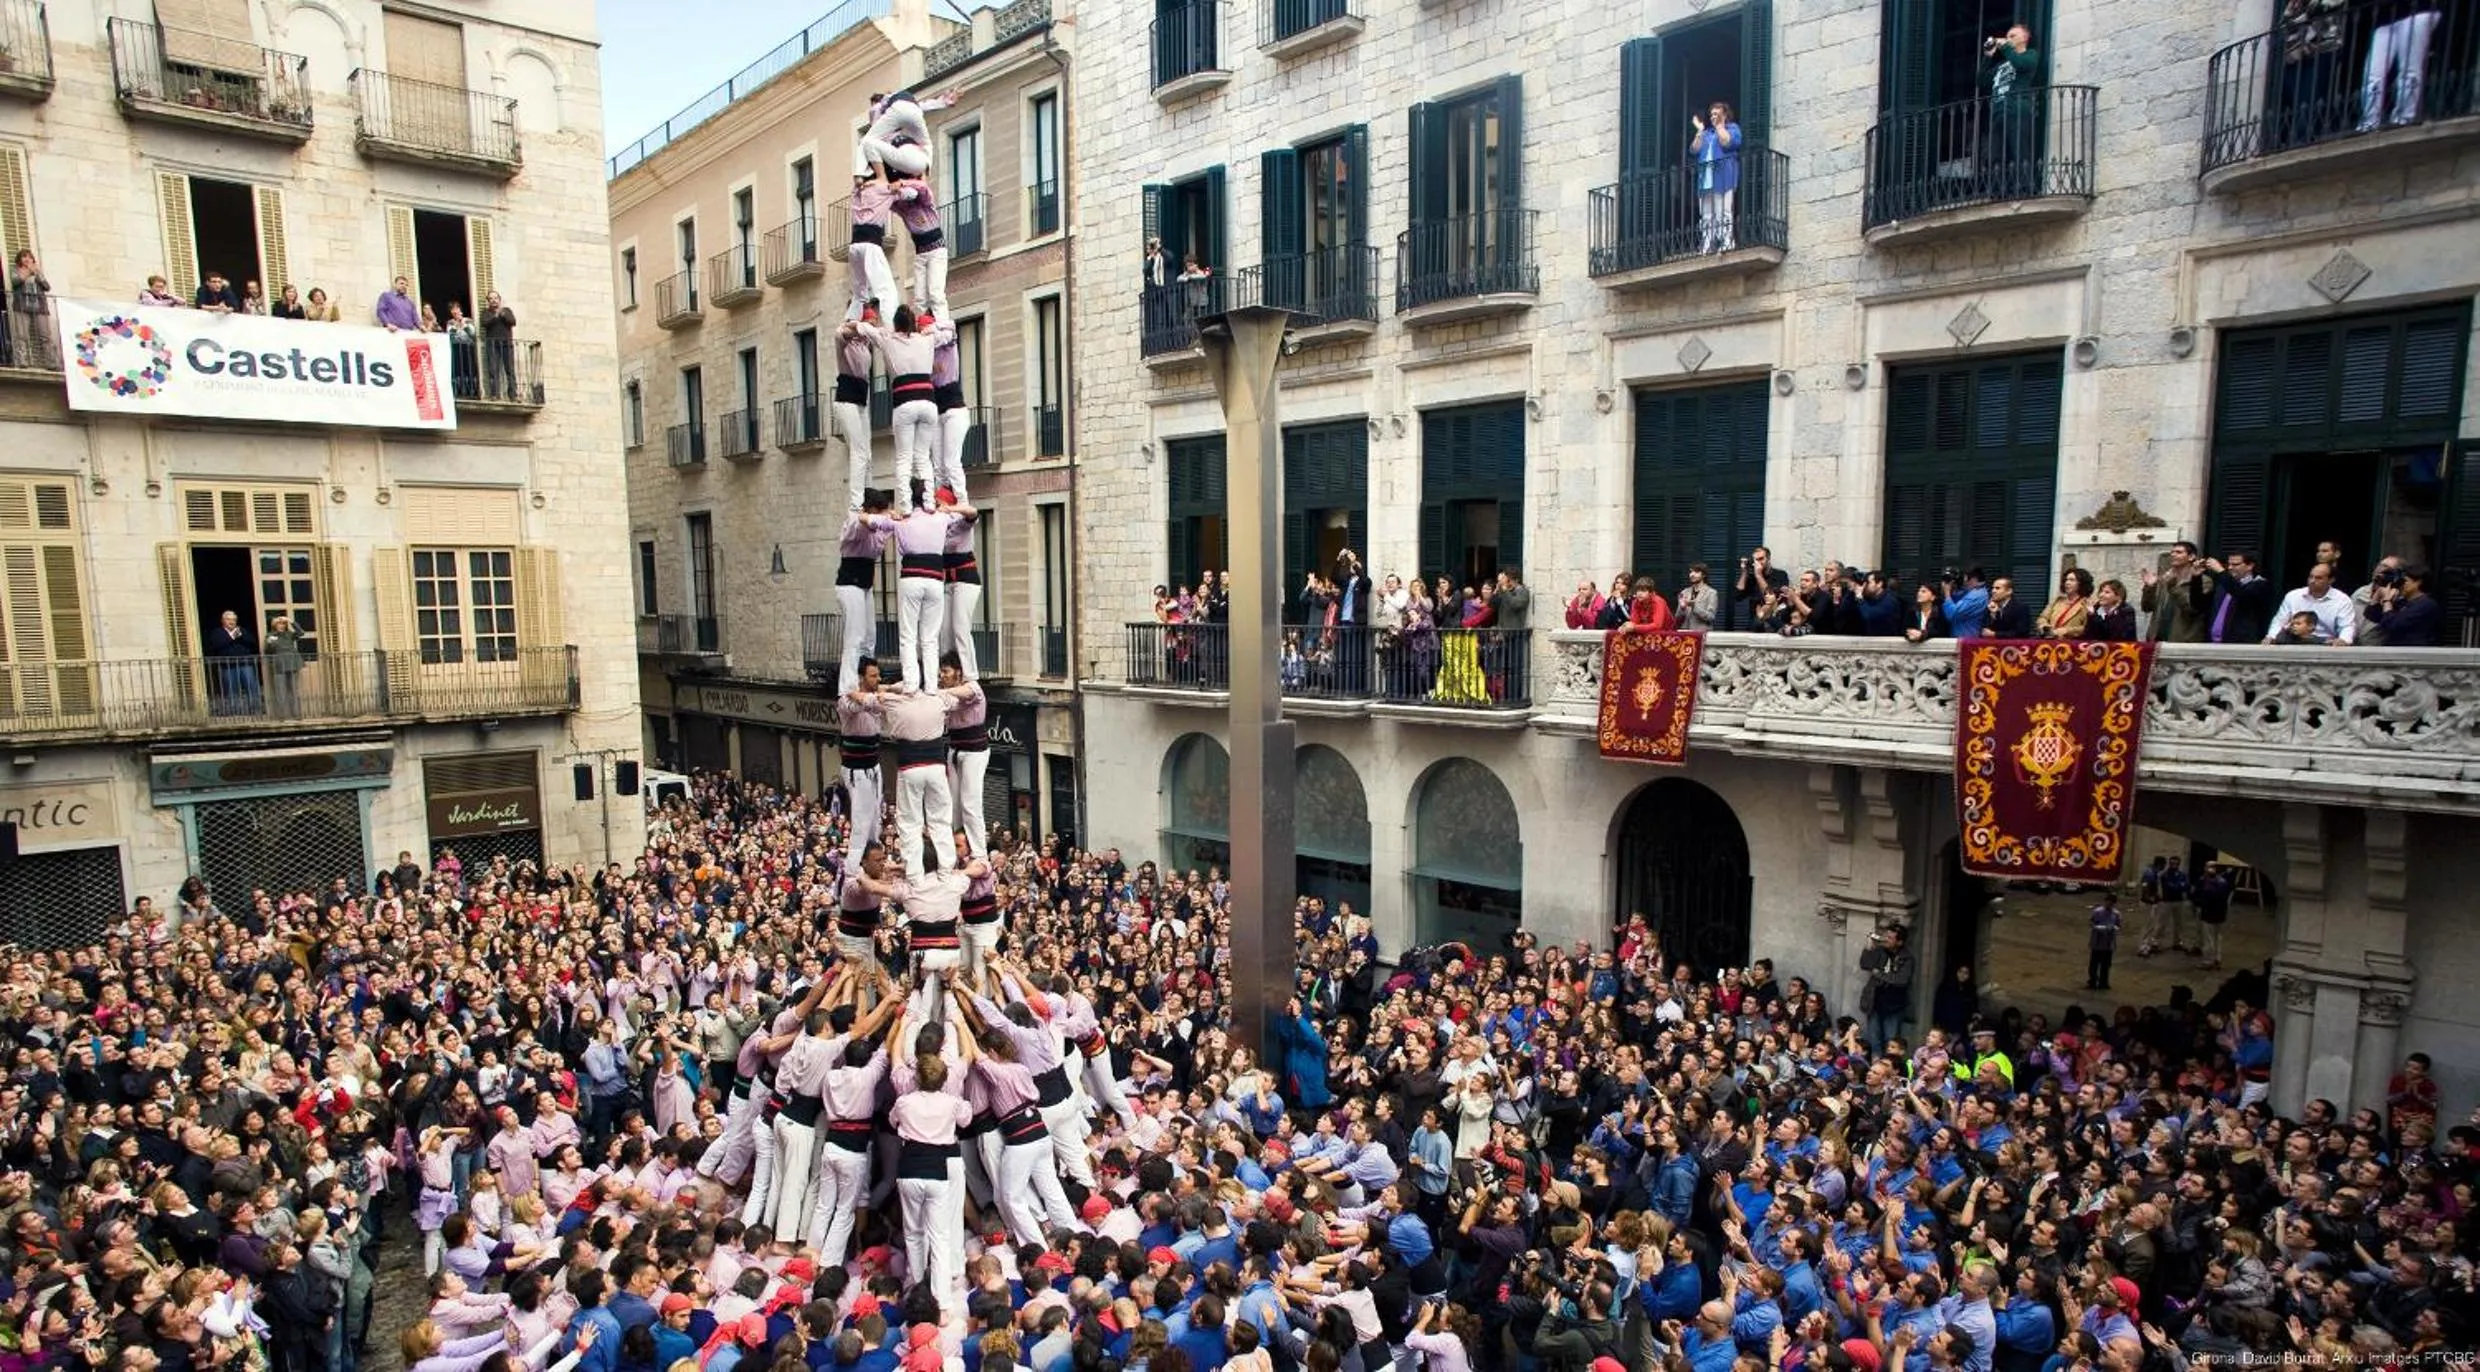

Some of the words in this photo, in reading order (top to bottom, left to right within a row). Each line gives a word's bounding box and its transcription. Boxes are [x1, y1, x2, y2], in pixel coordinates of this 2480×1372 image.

[186, 338, 394, 388] Castells
[794, 700, 841, 724] MORISC
[448, 801, 519, 824] Jardinet
